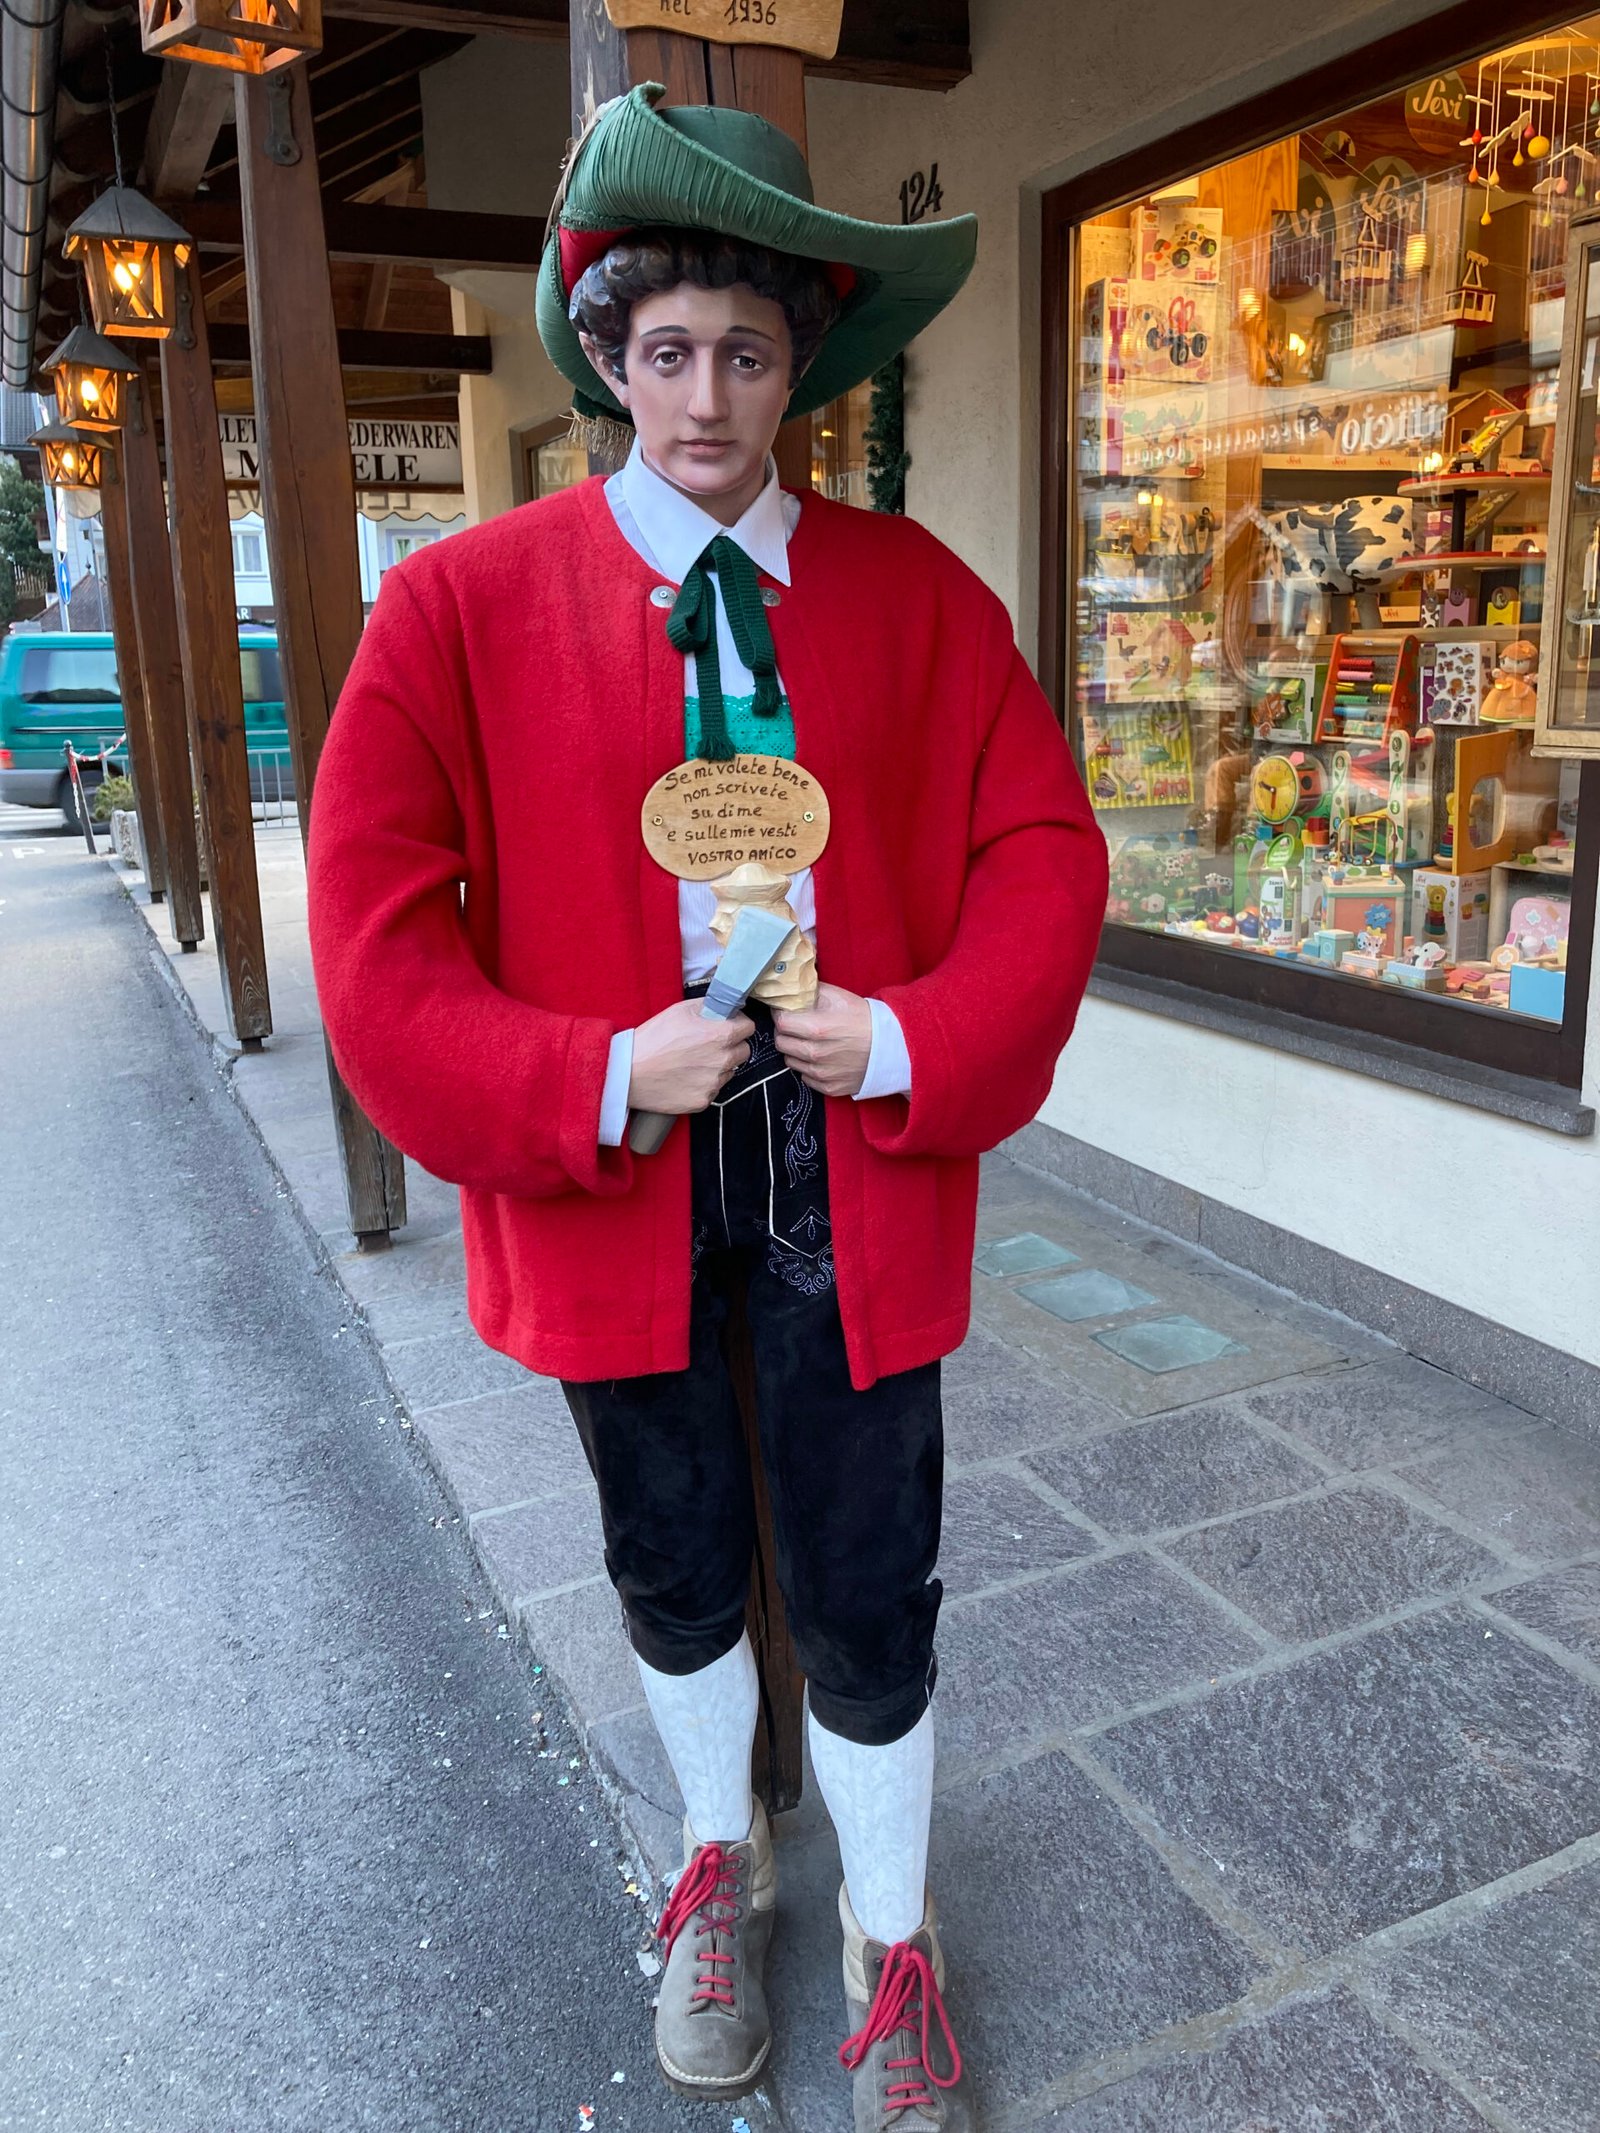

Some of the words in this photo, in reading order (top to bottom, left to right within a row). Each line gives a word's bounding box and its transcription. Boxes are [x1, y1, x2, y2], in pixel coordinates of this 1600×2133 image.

[723, 0, 777, 25] 1936
[1412, 78, 1463, 120] Sevi
[899, 162, 944, 225] 124
[1359, 174, 1421, 223] Sevi
[1272, 196, 1323, 239] evi
[664, 772, 691, 791] Se
[694, 761, 713, 780] mi
[716, 757, 767, 775] volete
[772, 759, 810, 790] bene
[683, 786, 711, 804] non
[715, 781, 788, 801] scrivete
[691, 807, 713, 819] su
[717, 803, 733, 818] di
[737, 805, 762, 817] me
[667, 830, 677, 842] e
[685, 825, 727, 841] sulle
[730, 824, 756, 838] mie
[760, 821, 797, 838] vesti
[687, 849, 744, 866] VOSTRO
